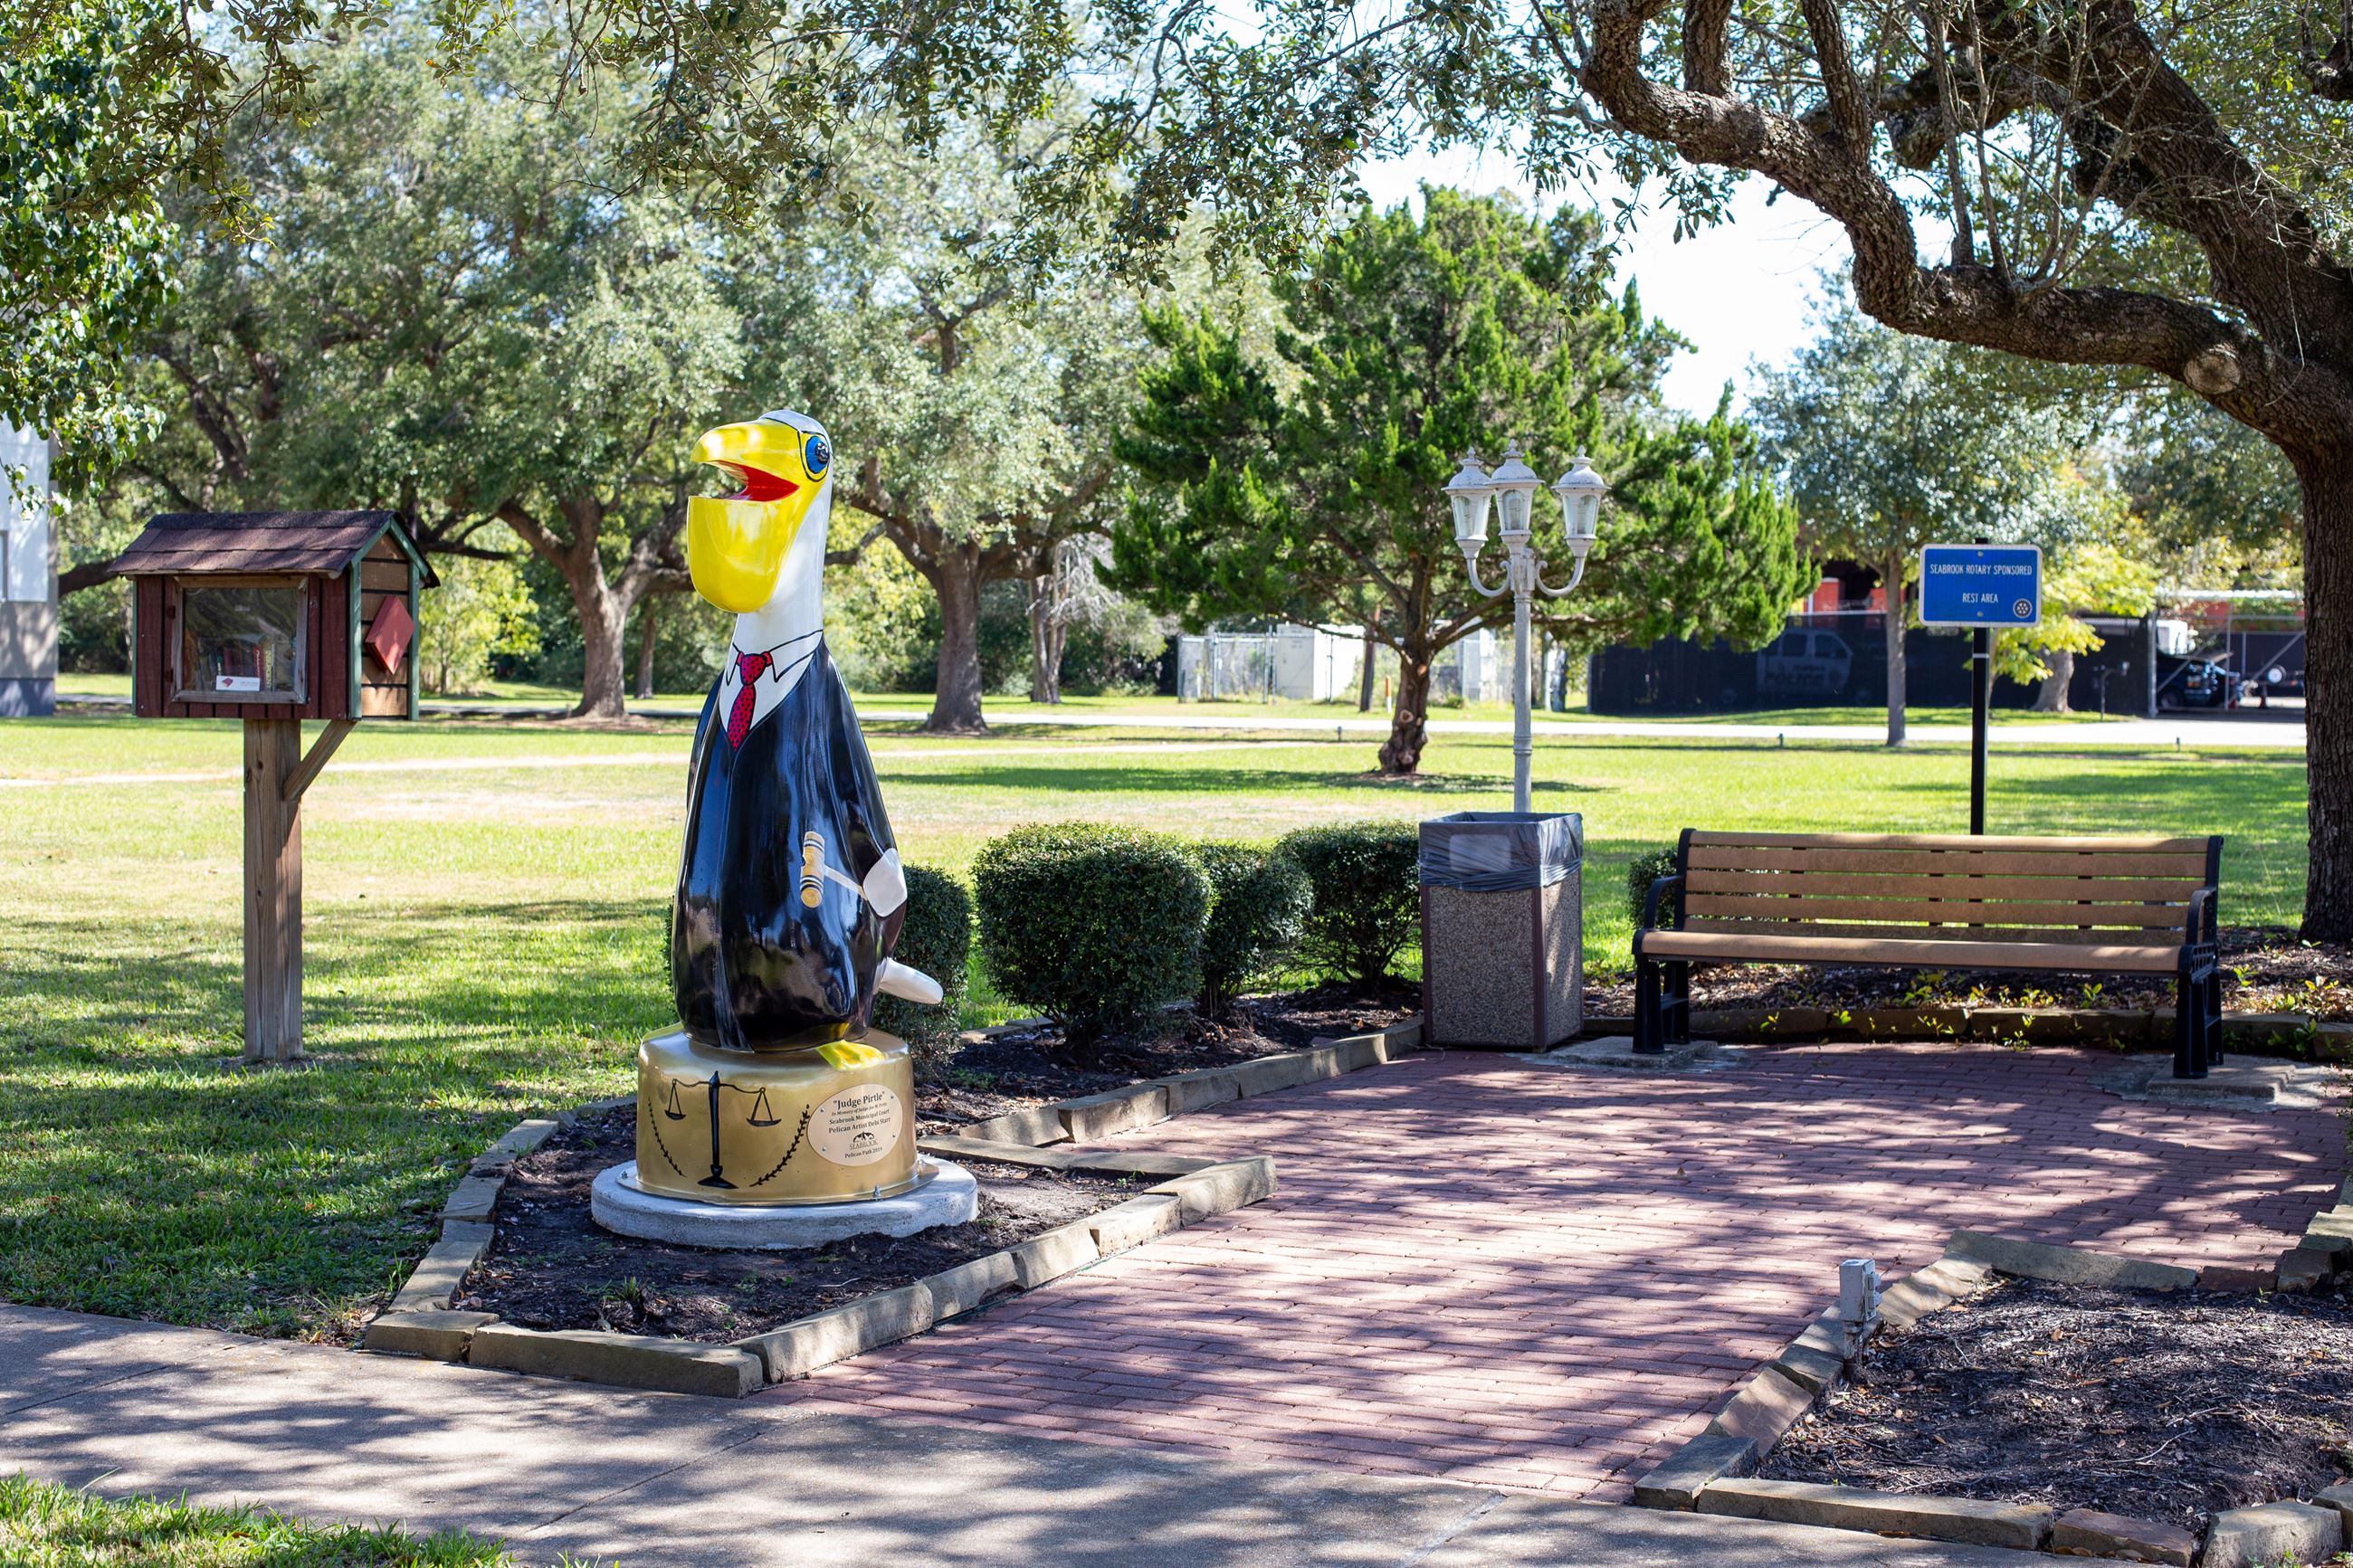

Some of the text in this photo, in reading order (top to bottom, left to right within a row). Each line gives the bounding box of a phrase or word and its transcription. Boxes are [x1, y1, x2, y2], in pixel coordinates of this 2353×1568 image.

[1929, 564, 2033, 575] SEABROOK ROTARY SPONSORED
[1962, 593, 1998, 603] REST AREA
[834, 1091, 885, 1109] "Judge Pirtle"
[855, 1112, 878, 1120] Municipal
[828, 1126, 851, 1134] Pelican
[849, 1140, 878, 1150] SEABROOK
